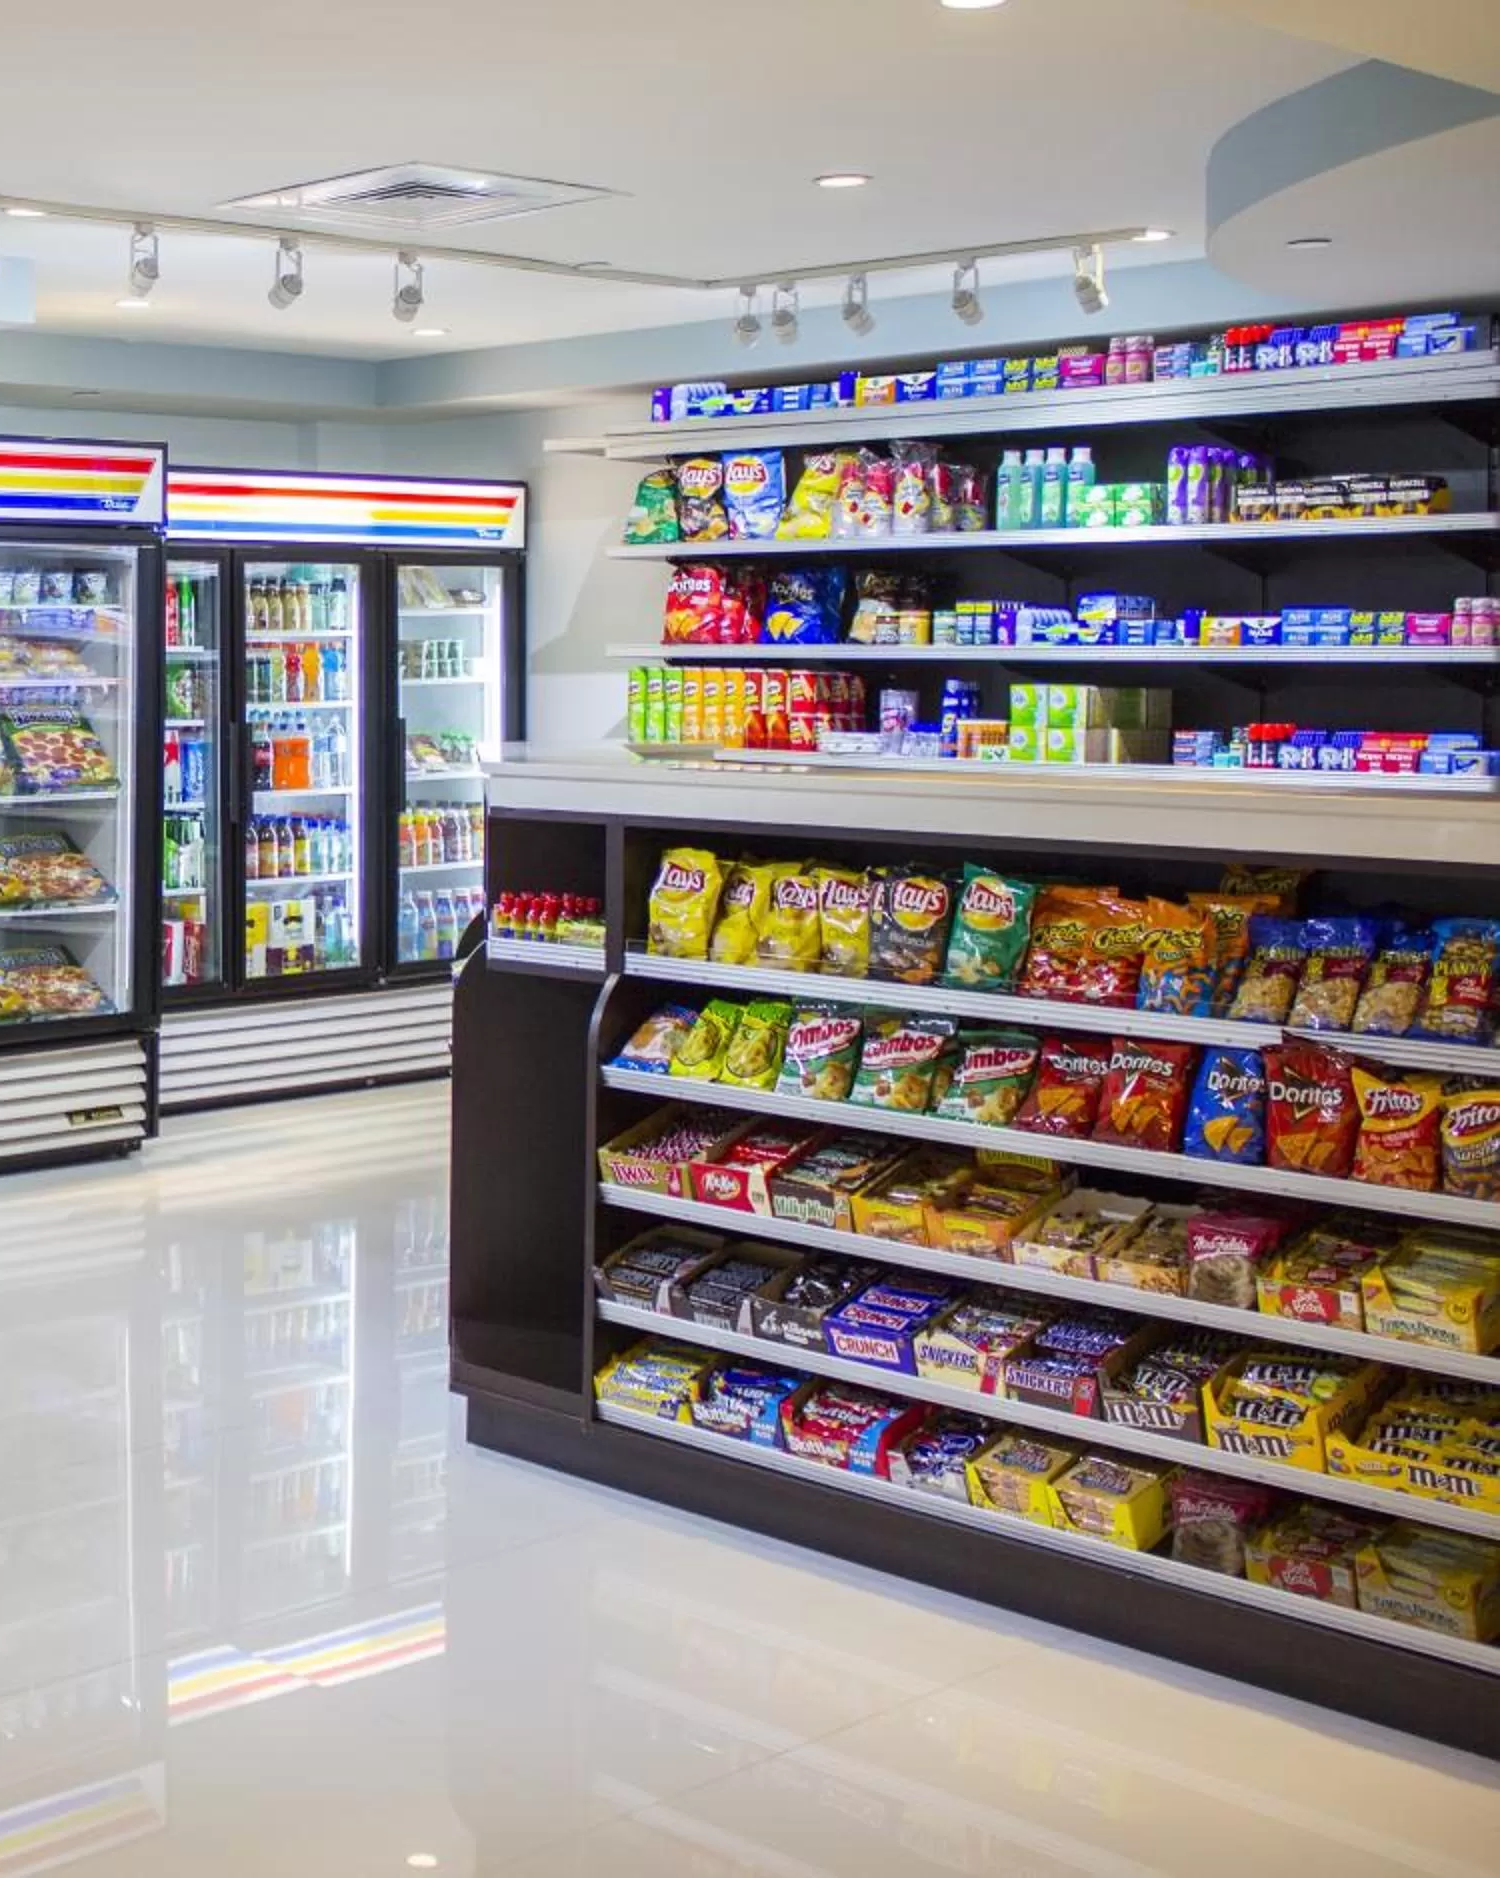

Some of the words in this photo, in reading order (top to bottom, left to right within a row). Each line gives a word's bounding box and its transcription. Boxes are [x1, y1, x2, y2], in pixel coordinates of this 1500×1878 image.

[1110, 1053, 1174, 1077] Doritos
[1270, 1081, 1344, 1106] Doritos
[1446, 1104, 1500, 1136] Frito
[842, 1305, 903, 1329] CRUNCH
[836, 1332, 896, 1361] CRUNCH
[919, 1344, 976, 1369] SNICKERS
[1006, 1365, 1071, 1397] SNICKERS
